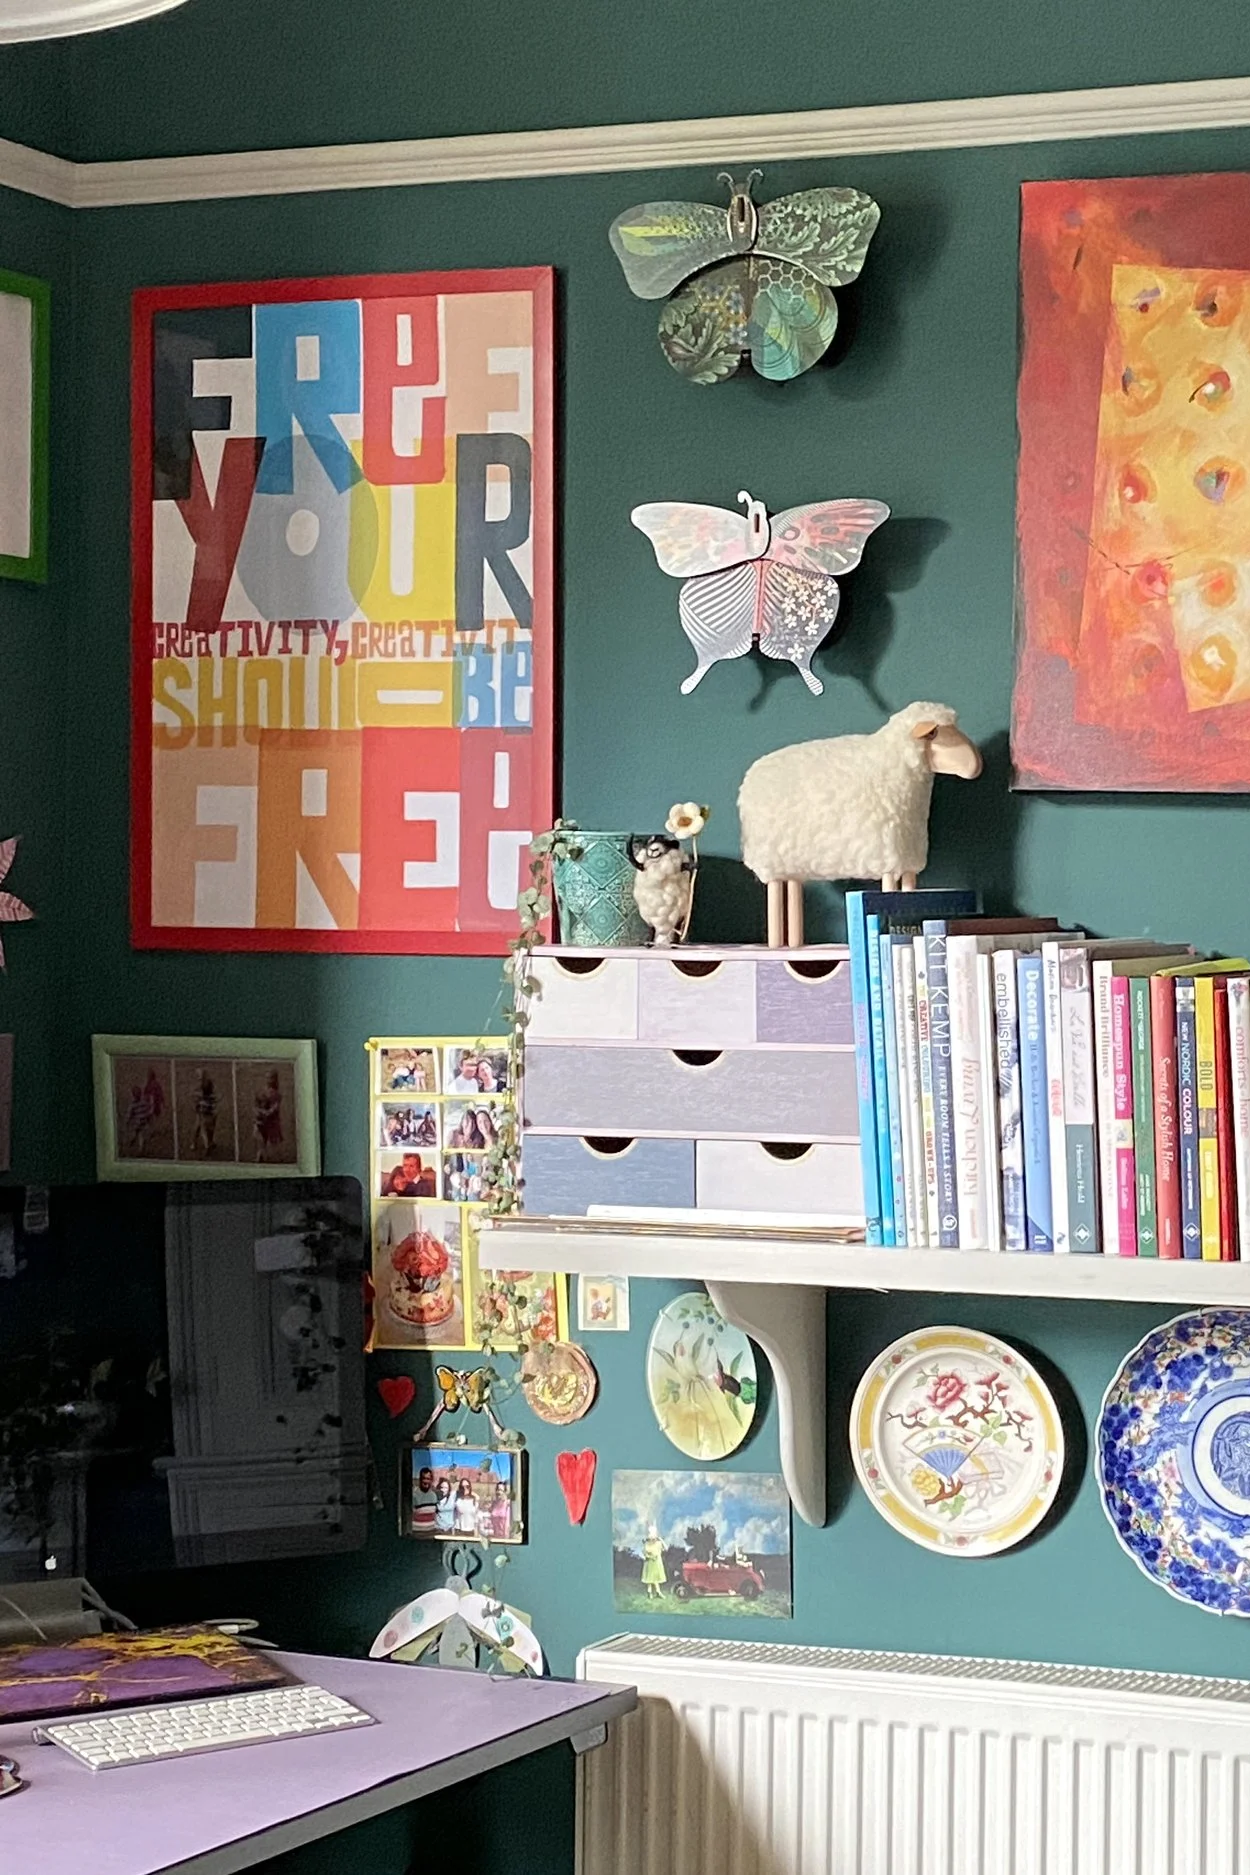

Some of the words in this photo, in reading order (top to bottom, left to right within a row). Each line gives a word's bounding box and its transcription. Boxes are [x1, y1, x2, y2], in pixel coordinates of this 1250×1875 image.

[928, 934, 949, 975] KIT
[1025, 969, 1040, 1041] Decorate
[1099, 975, 1110, 1013] Brand
[930, 985, 951, 1058] KEMP
[997, 973, 1012, 1069] embellished
[1113, 993, 1126, 1070] Homespun
[1181, 1021, 1189, 1041] NEW
[1101, 1016, 1112, 1078] Brilliance
[1182, 1042, 1192, 1086] NORDIC
[1235, 1026, 1249, 1089] comforts
[1114, 1073, 1128, 1111] Style
[1159, 1057, 1171, 1091] Secrets
[1200, 1060, 1213, 1091] BOLD
[939, 1098, 950, 1128] ROOM
[1158, 1093, 1172, 1105] of
[1161, 1105, 1169, 1113] a
[1182, 1088, 1193, 1135] COLOUR
[1159, 1114, 1173, 1148] Stylish
[1162, 1150, 1174, 1182] Home
[943, 1170, 953, 1204] STORY
